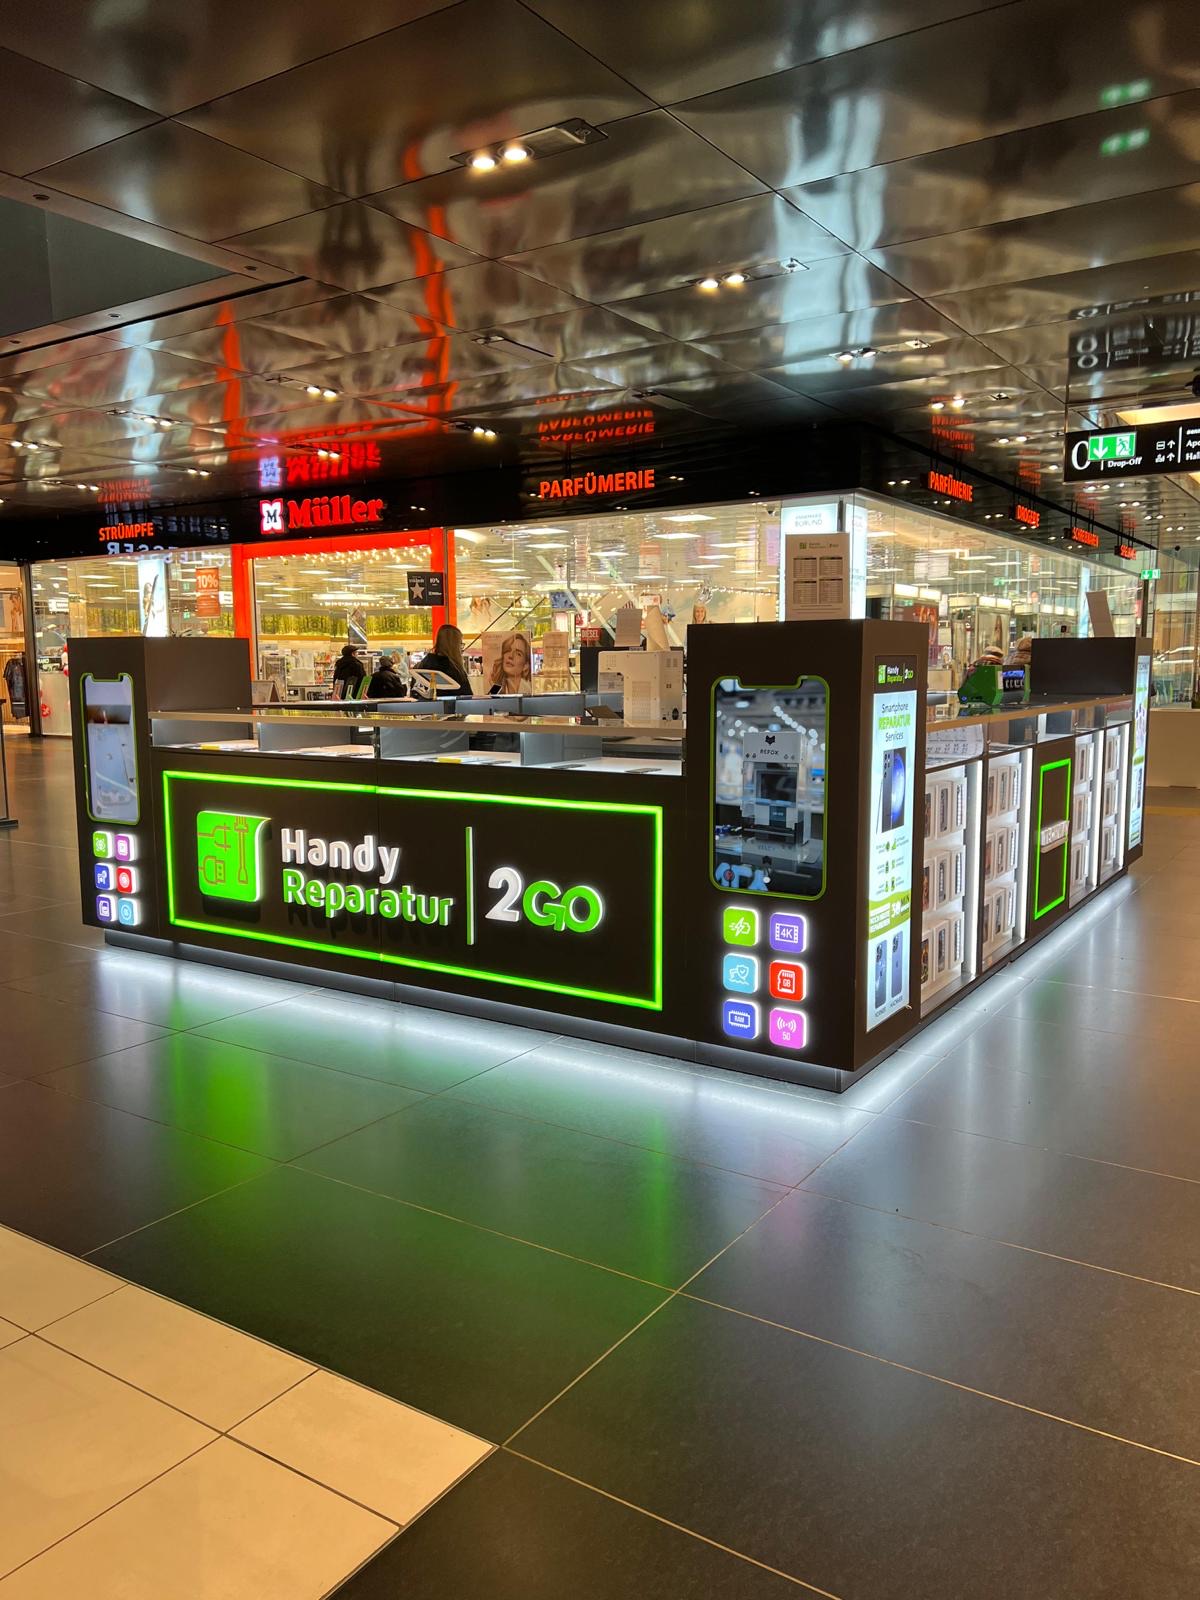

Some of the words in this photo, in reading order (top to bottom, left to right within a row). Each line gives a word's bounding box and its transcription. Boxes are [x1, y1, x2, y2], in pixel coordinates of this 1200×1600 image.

[1107, 456, 1143, 468] Drop-Off
[540, 468, 656, 499] PARFÜMERIE
[928, 470, 974, 503] PARFÜMERIE
[287, 494, 384, 529] Müller
[98, 521, 155, 541] STRÜMPFE
[197, 574, 219, 589] 10%
[881, 702, 909, 714] Smartphone
[878, 713, 911, 730] REPARATUR
[281, 828, 400, 884] Handy
[282, 868, 454, 926] Reparatur
[485, 866, 604, 933] 2GO
[780, 928, 794, 940] 4K
